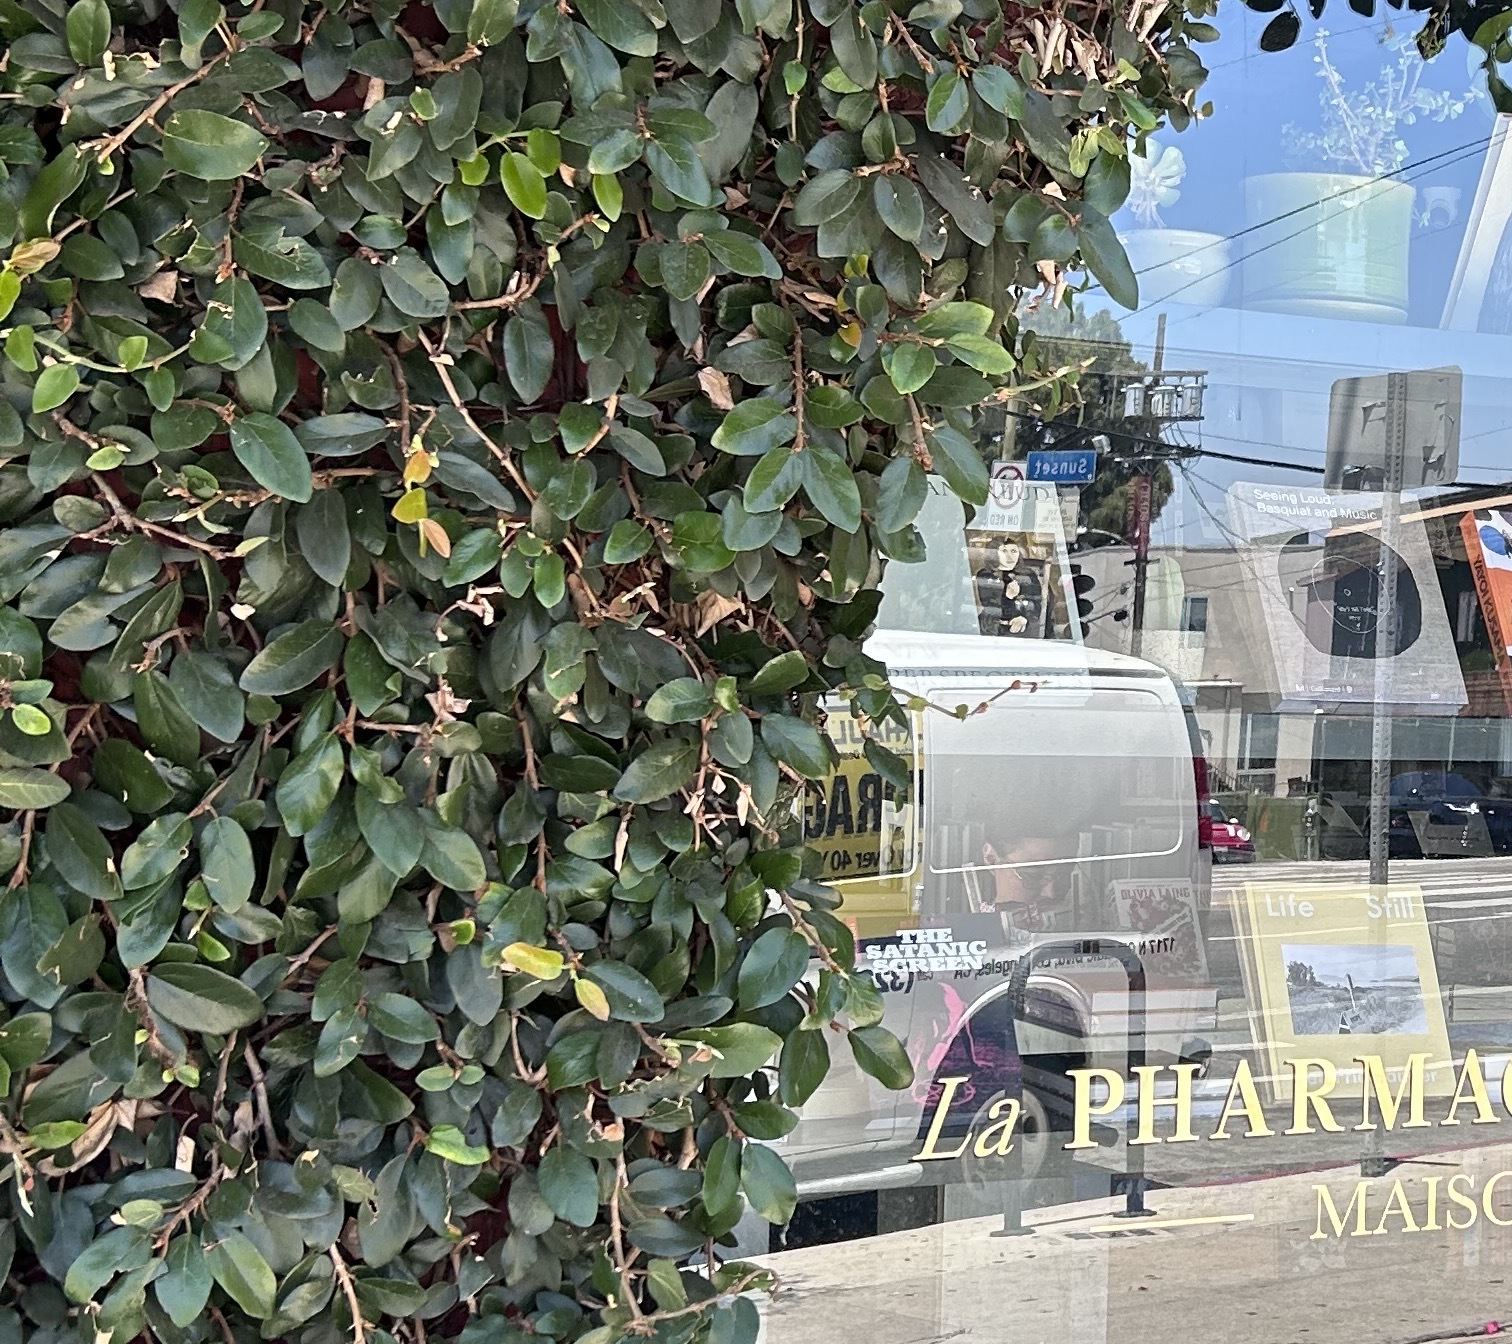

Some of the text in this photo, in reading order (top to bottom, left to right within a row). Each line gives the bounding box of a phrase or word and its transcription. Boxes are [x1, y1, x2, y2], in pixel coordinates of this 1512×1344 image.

[1253, 488, 1298, 505] Seeing
[1256, 501, 1378, 520] Basquiat and Music
[1473, 552, 1505, 662] YAYOI KUSAMA
[1120, 887, 1191, 900] OLIVIA LAING
[1264, 893, 1415, 919] Life Still
[896, 928, 953, 944] THE
[865, 940, 988, 959] SATANIC
[872, 955, 984, 974] SCREEN
[910, 1074, 1027, 1161] La
